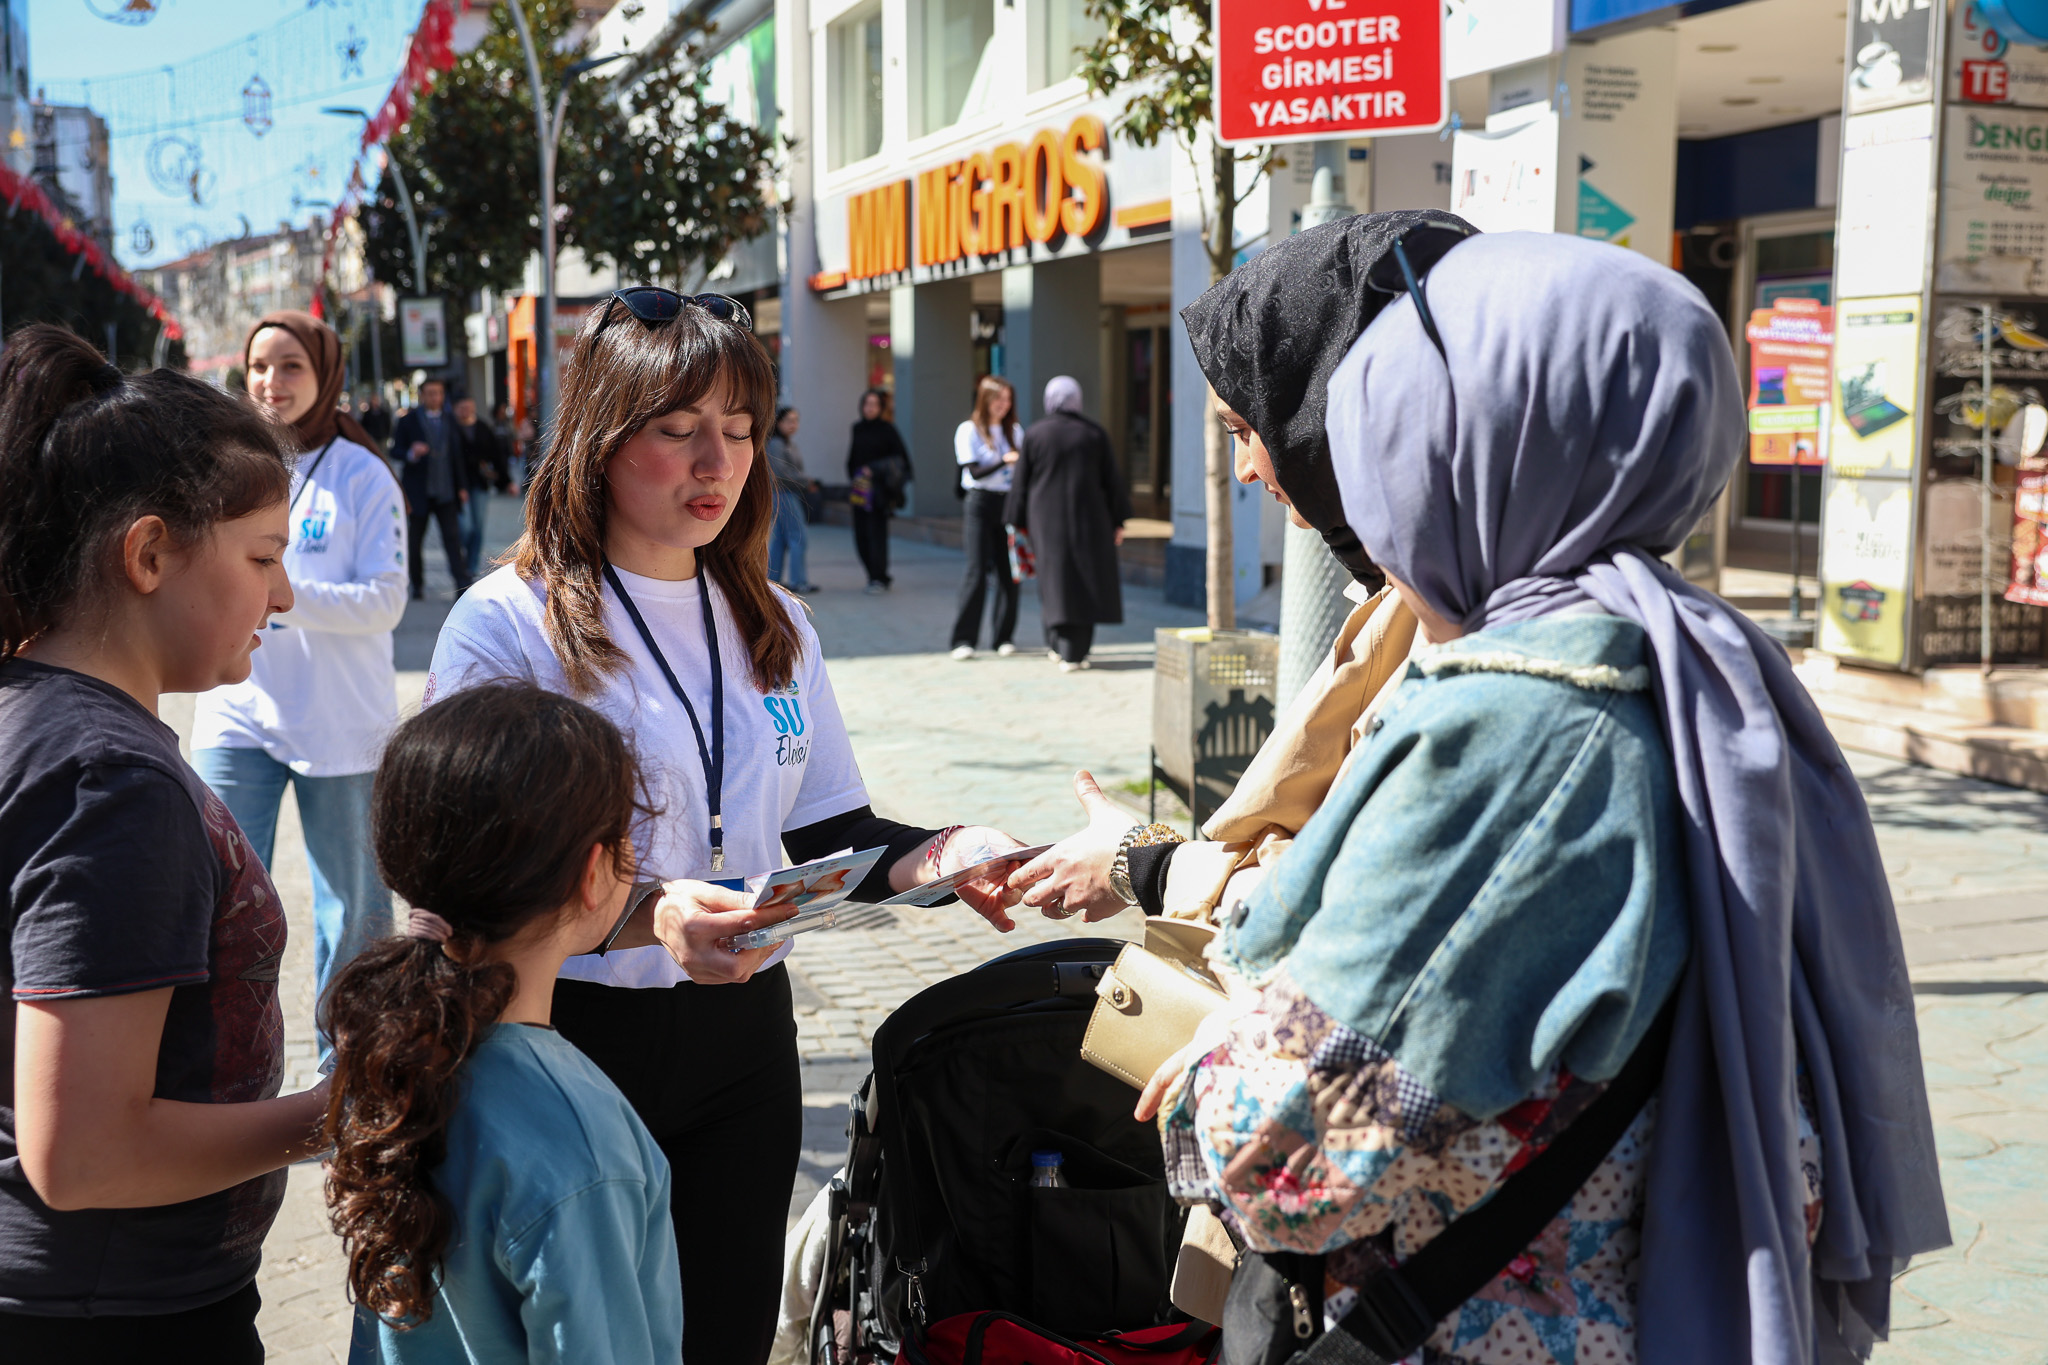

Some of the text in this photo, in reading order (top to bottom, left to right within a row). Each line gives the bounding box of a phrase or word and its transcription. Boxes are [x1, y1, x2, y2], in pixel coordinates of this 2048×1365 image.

[1254, 15, 1401, 54] SCOOTER
[1261, 47, 1393, 90] GİRMESİ
[1250, 90, 1407, 127] YASAKTIR
[847, 179, 909, 281] MM
[763, 696, 805, 736] SU
